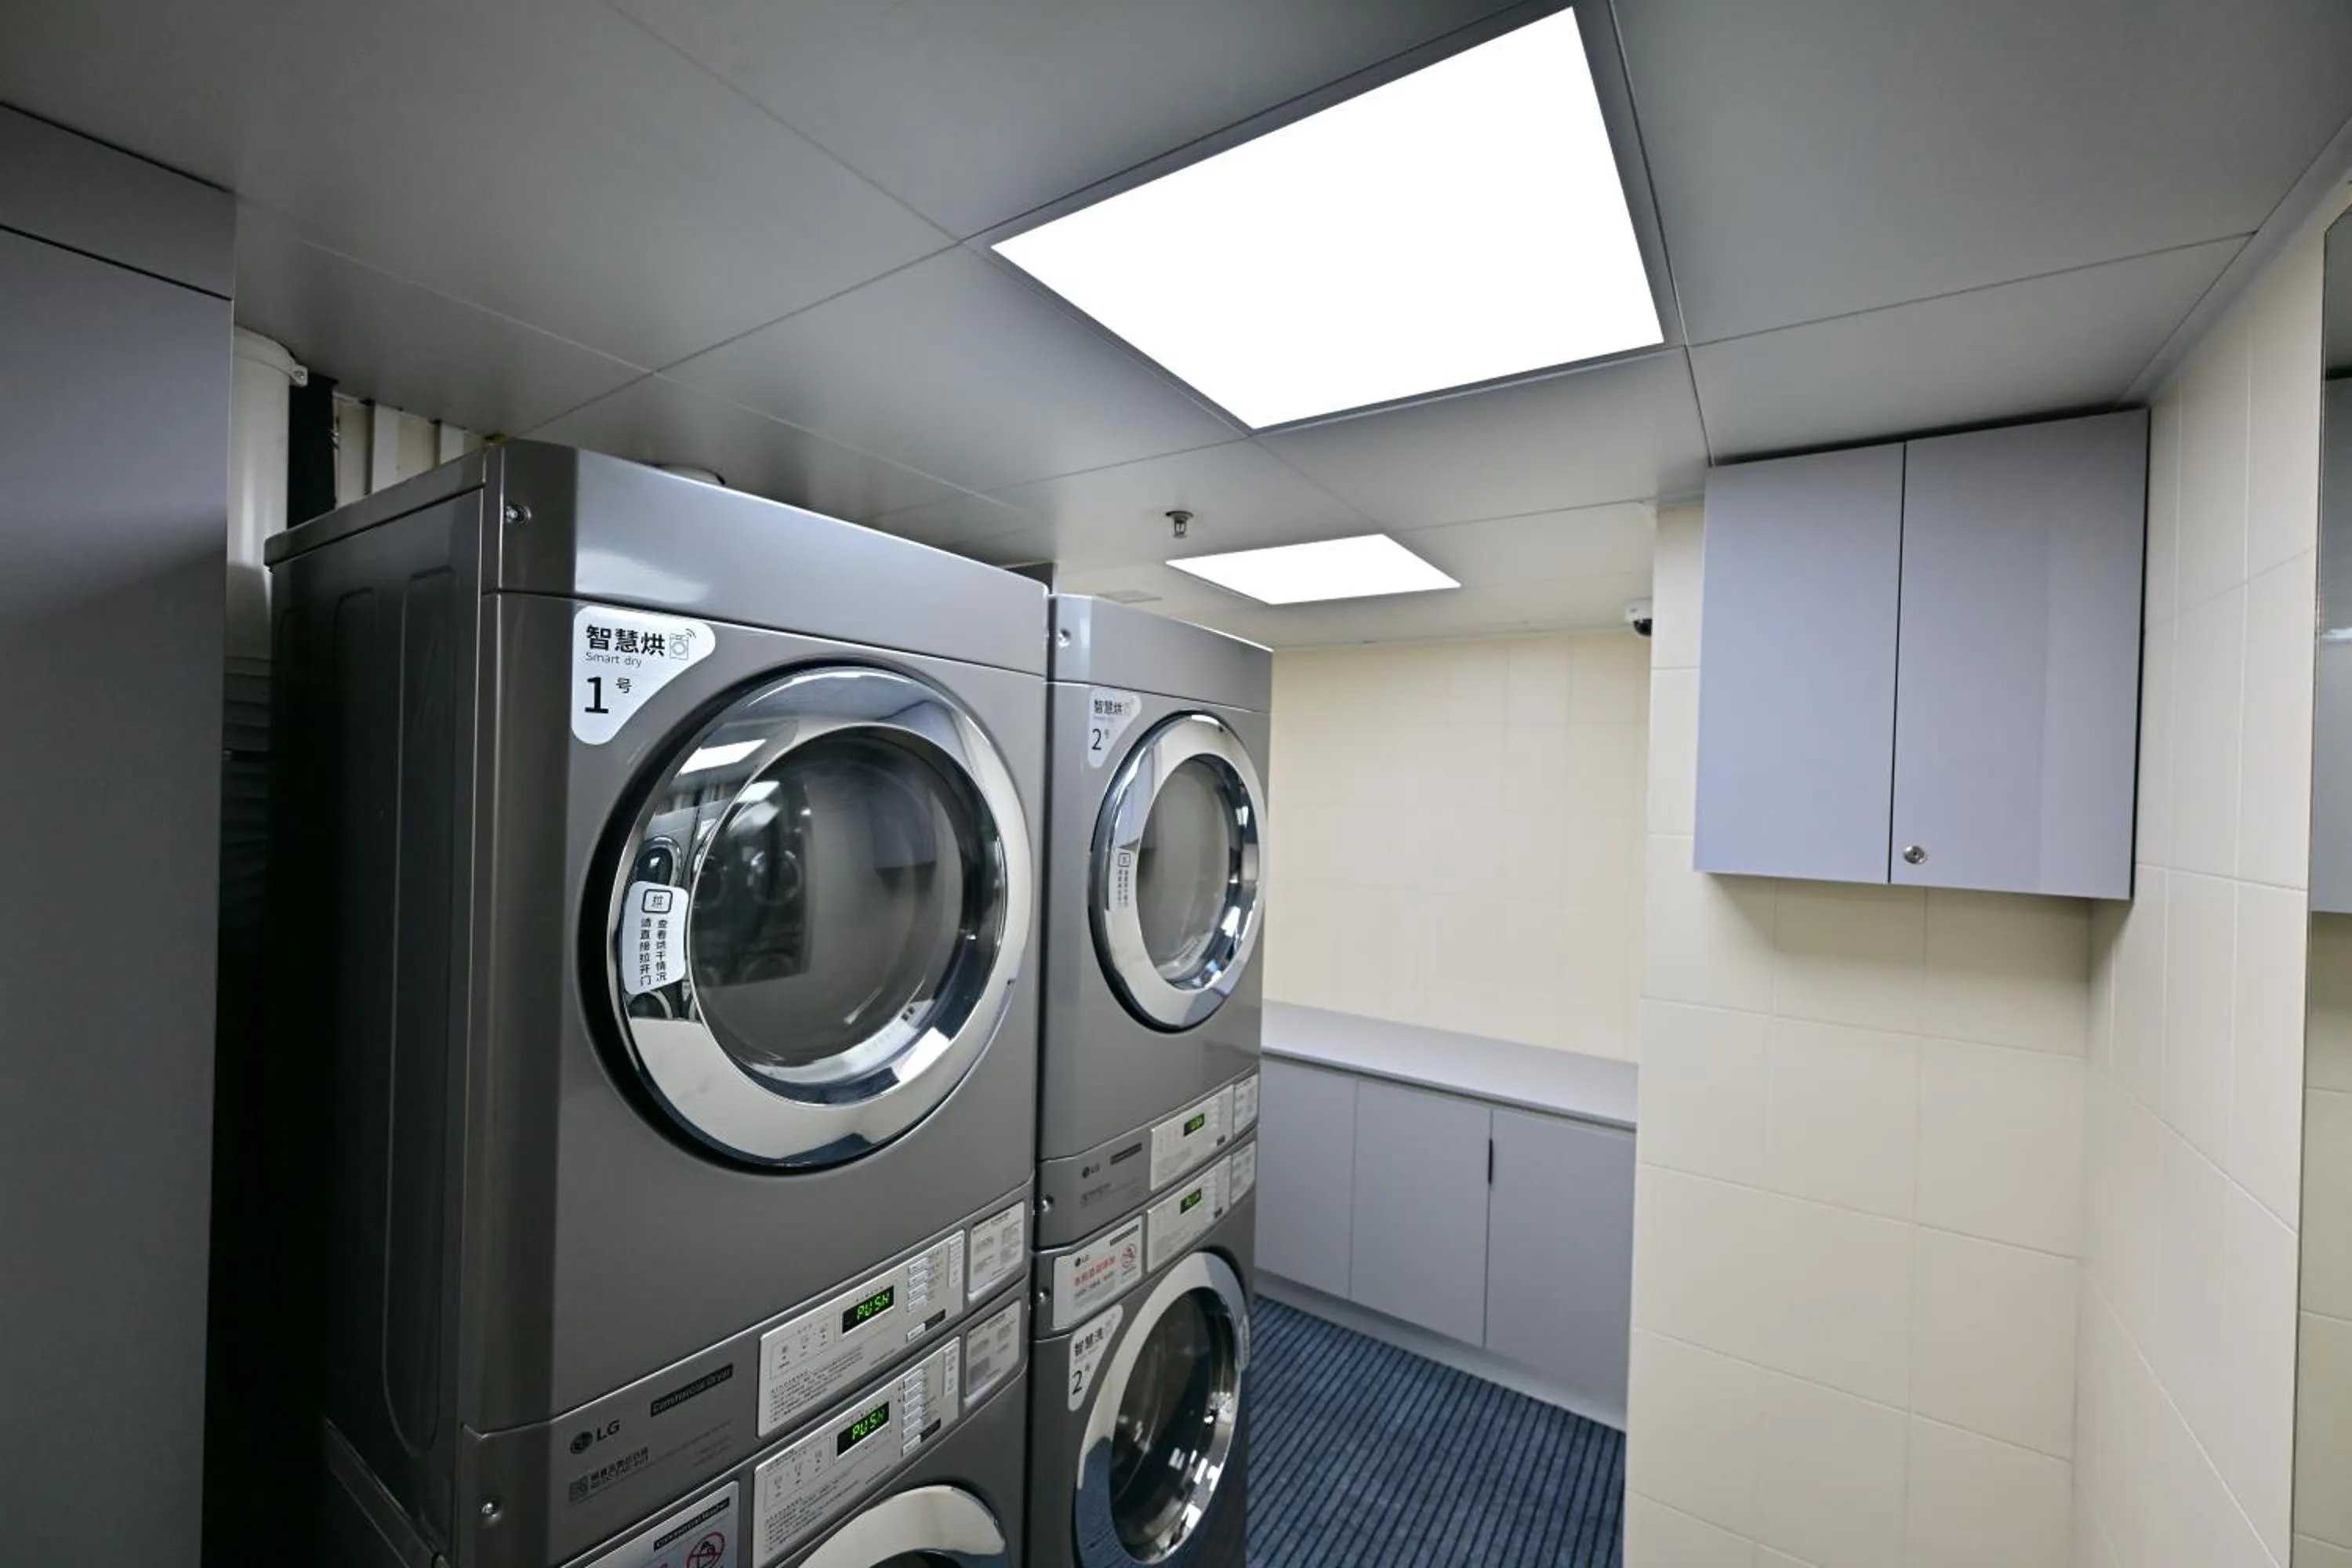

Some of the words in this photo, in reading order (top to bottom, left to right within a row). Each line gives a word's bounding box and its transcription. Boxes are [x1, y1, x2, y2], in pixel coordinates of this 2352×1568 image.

[586, 624, 665, 657] 智慧烘
[585, 652, 619, 665] Smart
[623, 654, 642, 668] dry
[857, 1291, 890, 1320] PUSH
[597, 1419, 620, 1442] LG
